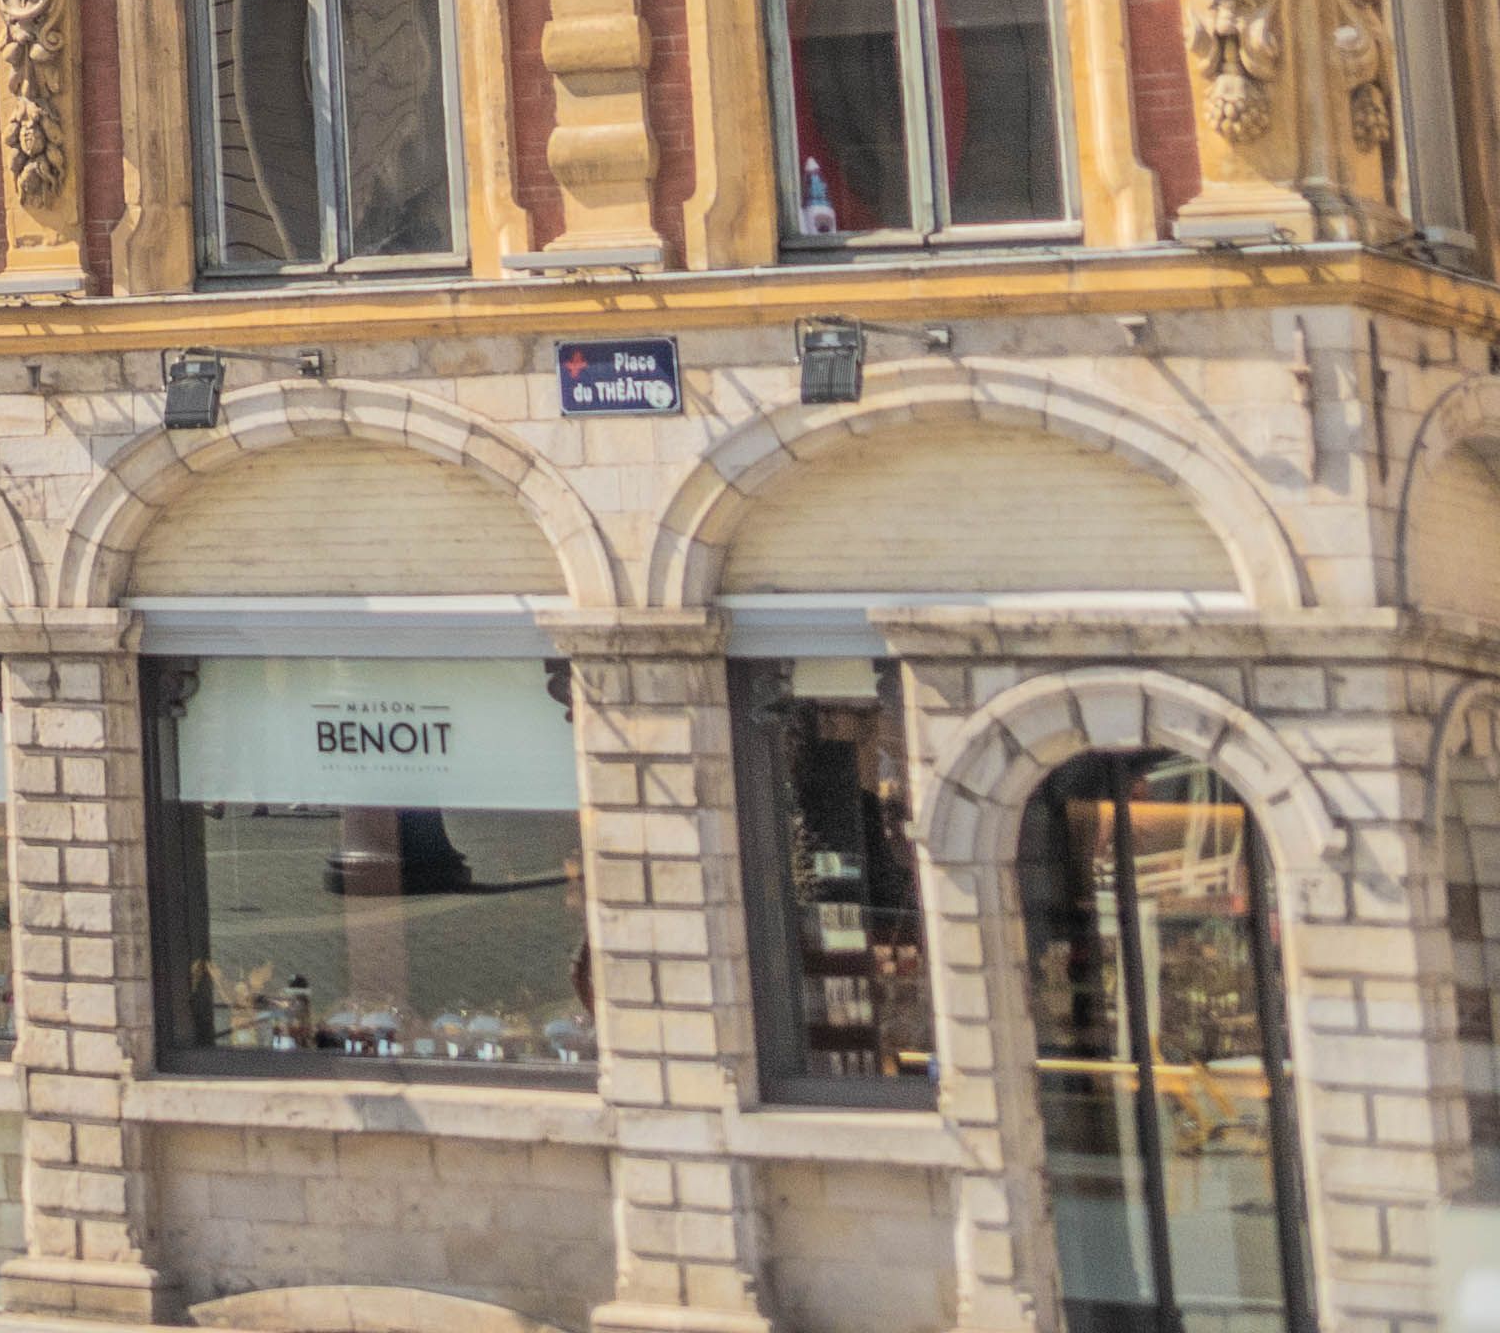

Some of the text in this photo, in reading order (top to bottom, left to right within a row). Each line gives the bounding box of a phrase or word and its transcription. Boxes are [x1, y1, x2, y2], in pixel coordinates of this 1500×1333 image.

[614, 352, 656, 372] Place
[573, 382, 593, 402] du
[347, 701, 416, 713] MAISON
[317, 721, 452, 754] BENOIT
